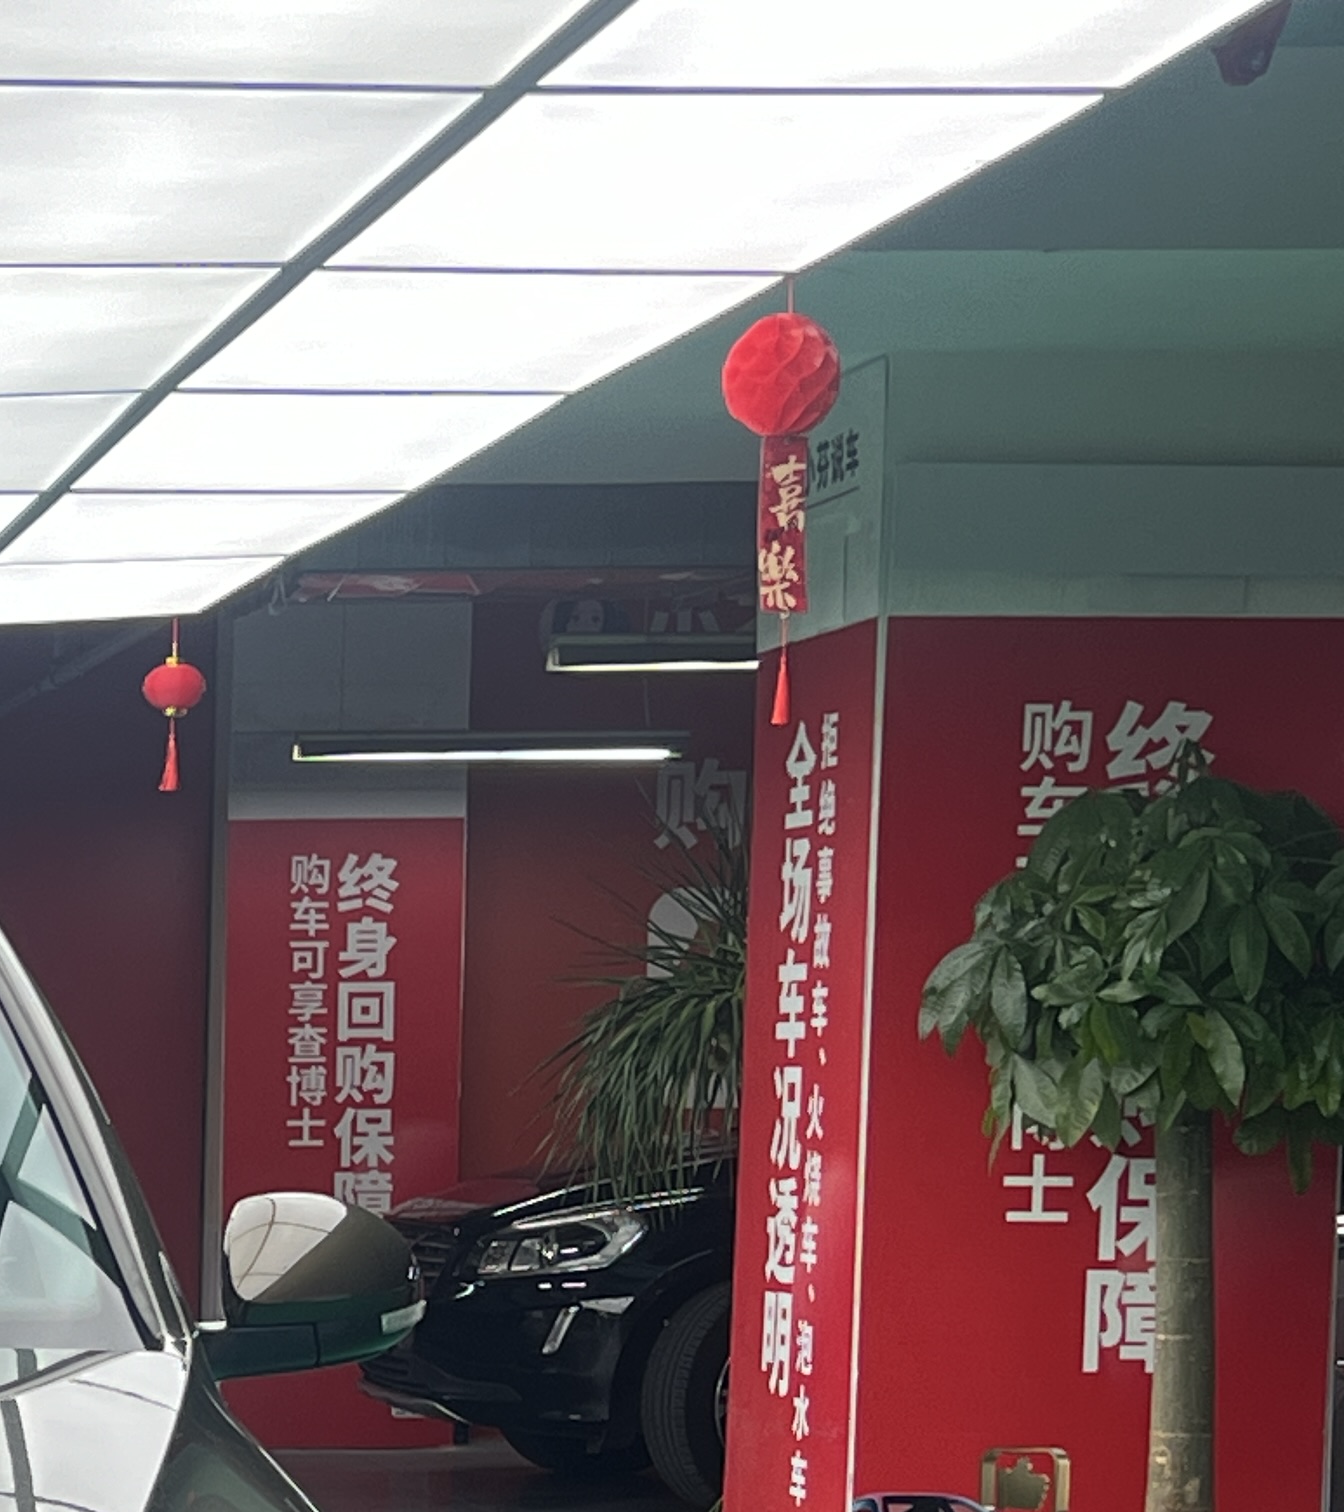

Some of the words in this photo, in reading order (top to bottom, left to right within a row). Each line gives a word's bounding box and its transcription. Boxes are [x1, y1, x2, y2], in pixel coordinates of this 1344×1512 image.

[286, 854, 331, 1148] 购车可享查博士
[761, 720, 816, 1397] 全场车况透明
